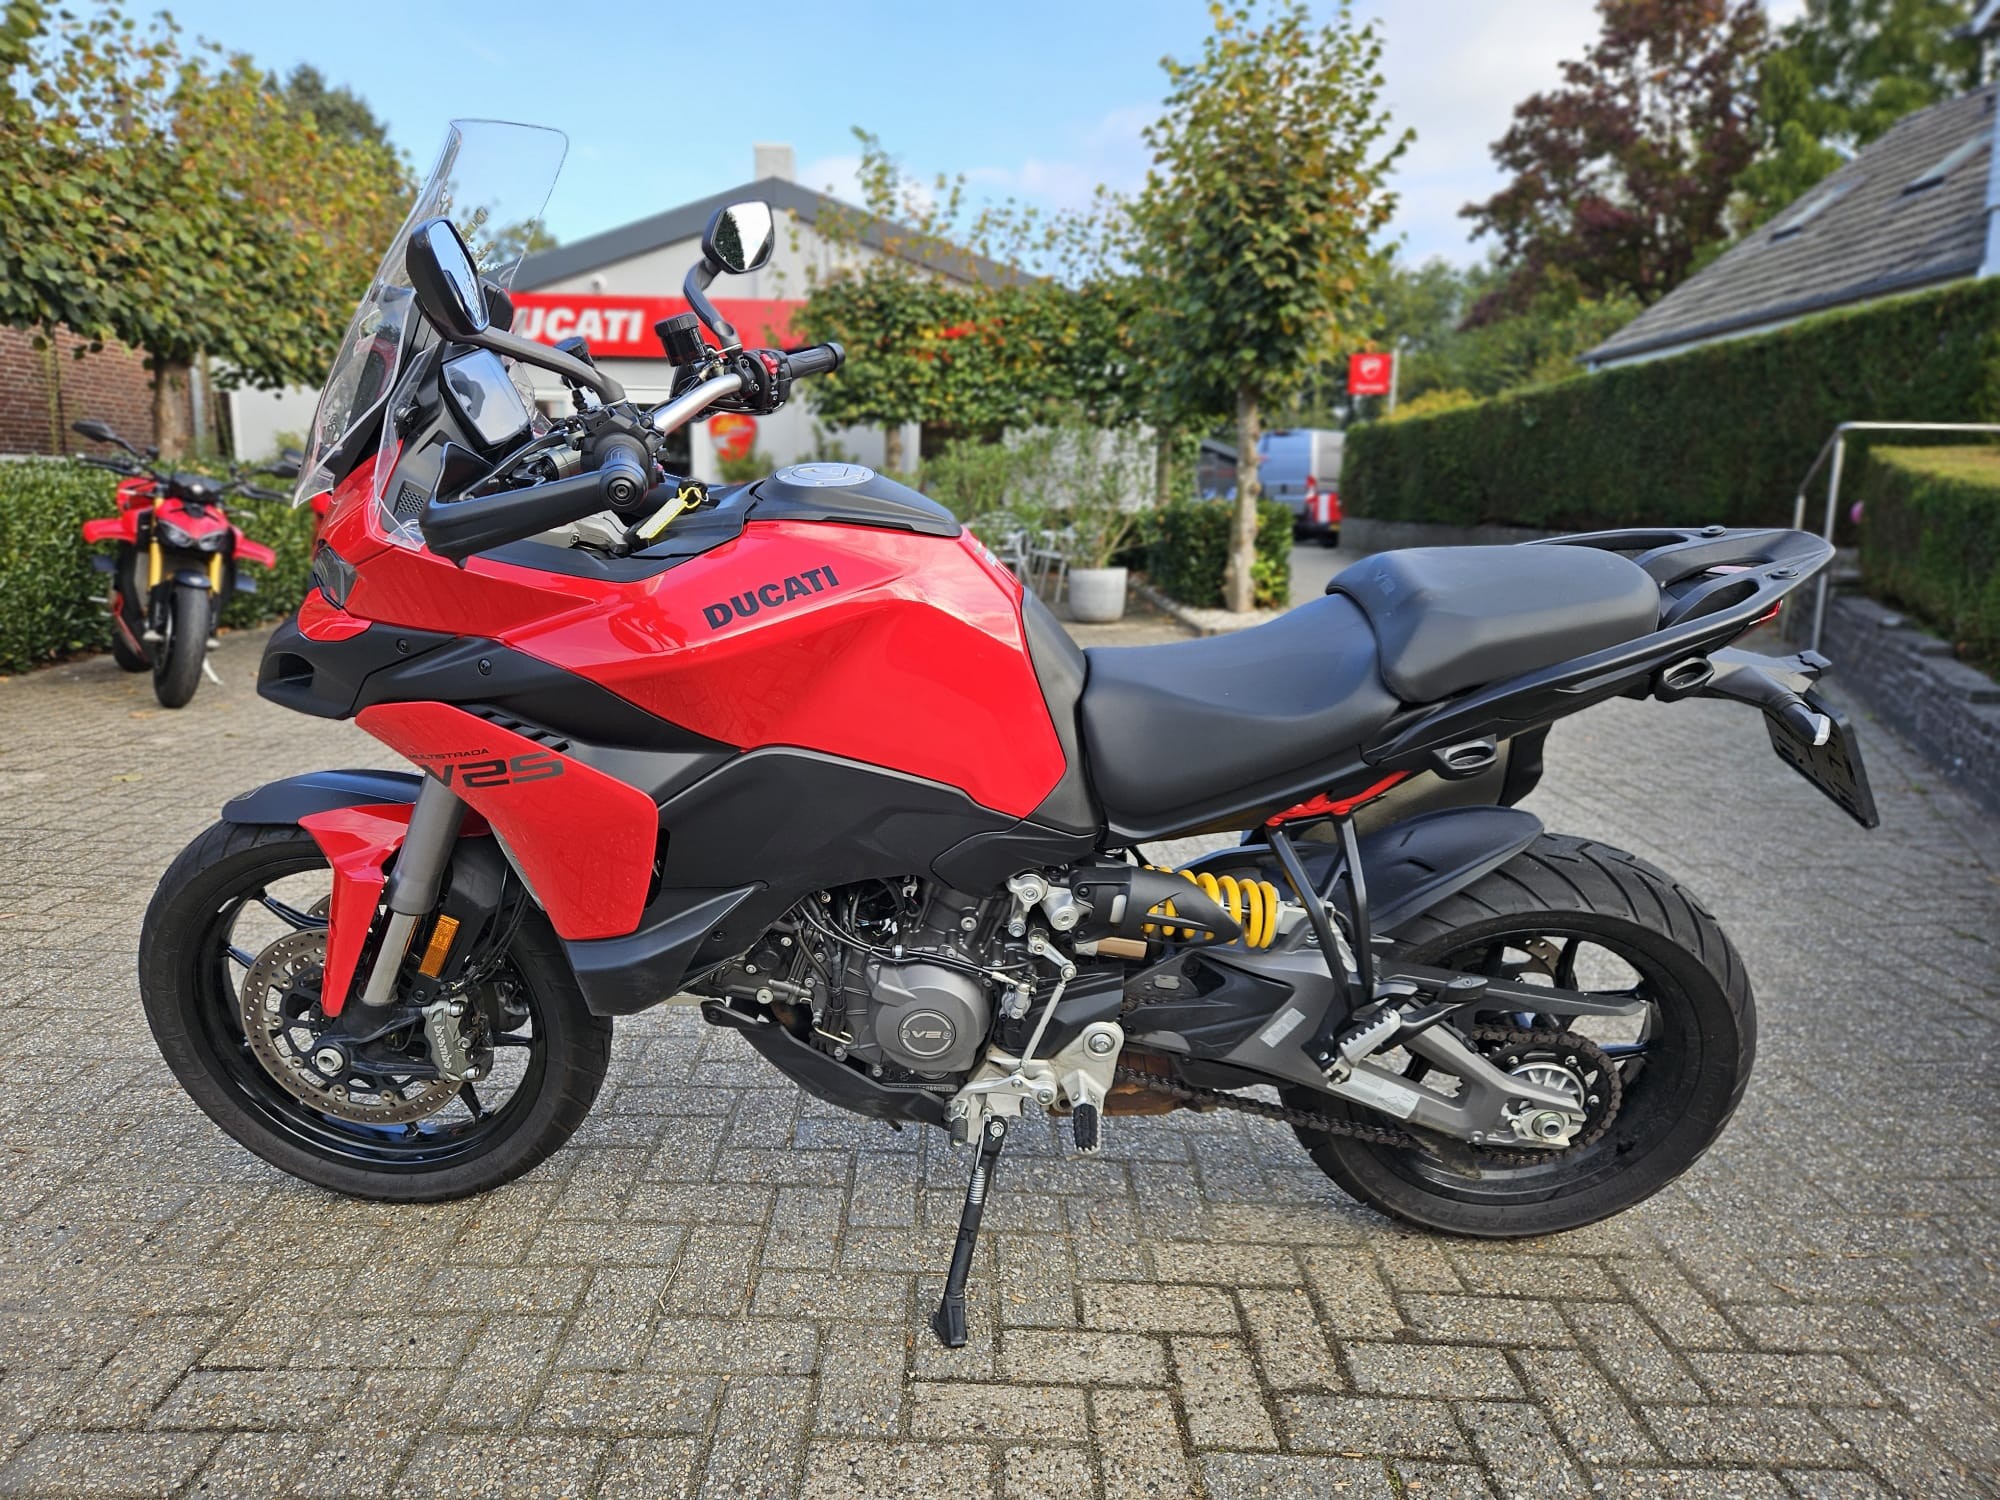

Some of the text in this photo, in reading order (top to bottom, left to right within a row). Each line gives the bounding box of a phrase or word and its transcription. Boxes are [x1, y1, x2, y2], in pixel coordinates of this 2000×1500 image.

[510, 306, 645, 342] UCATI
[703, 565, 839, 630] DUCATI
[408, 748, 490, 760] MULTISTRADA
[420, 751, 565, 788] V2S
[433, 1025, 453, 1069] brembo
[911, 1030, 942, 1039] V2
